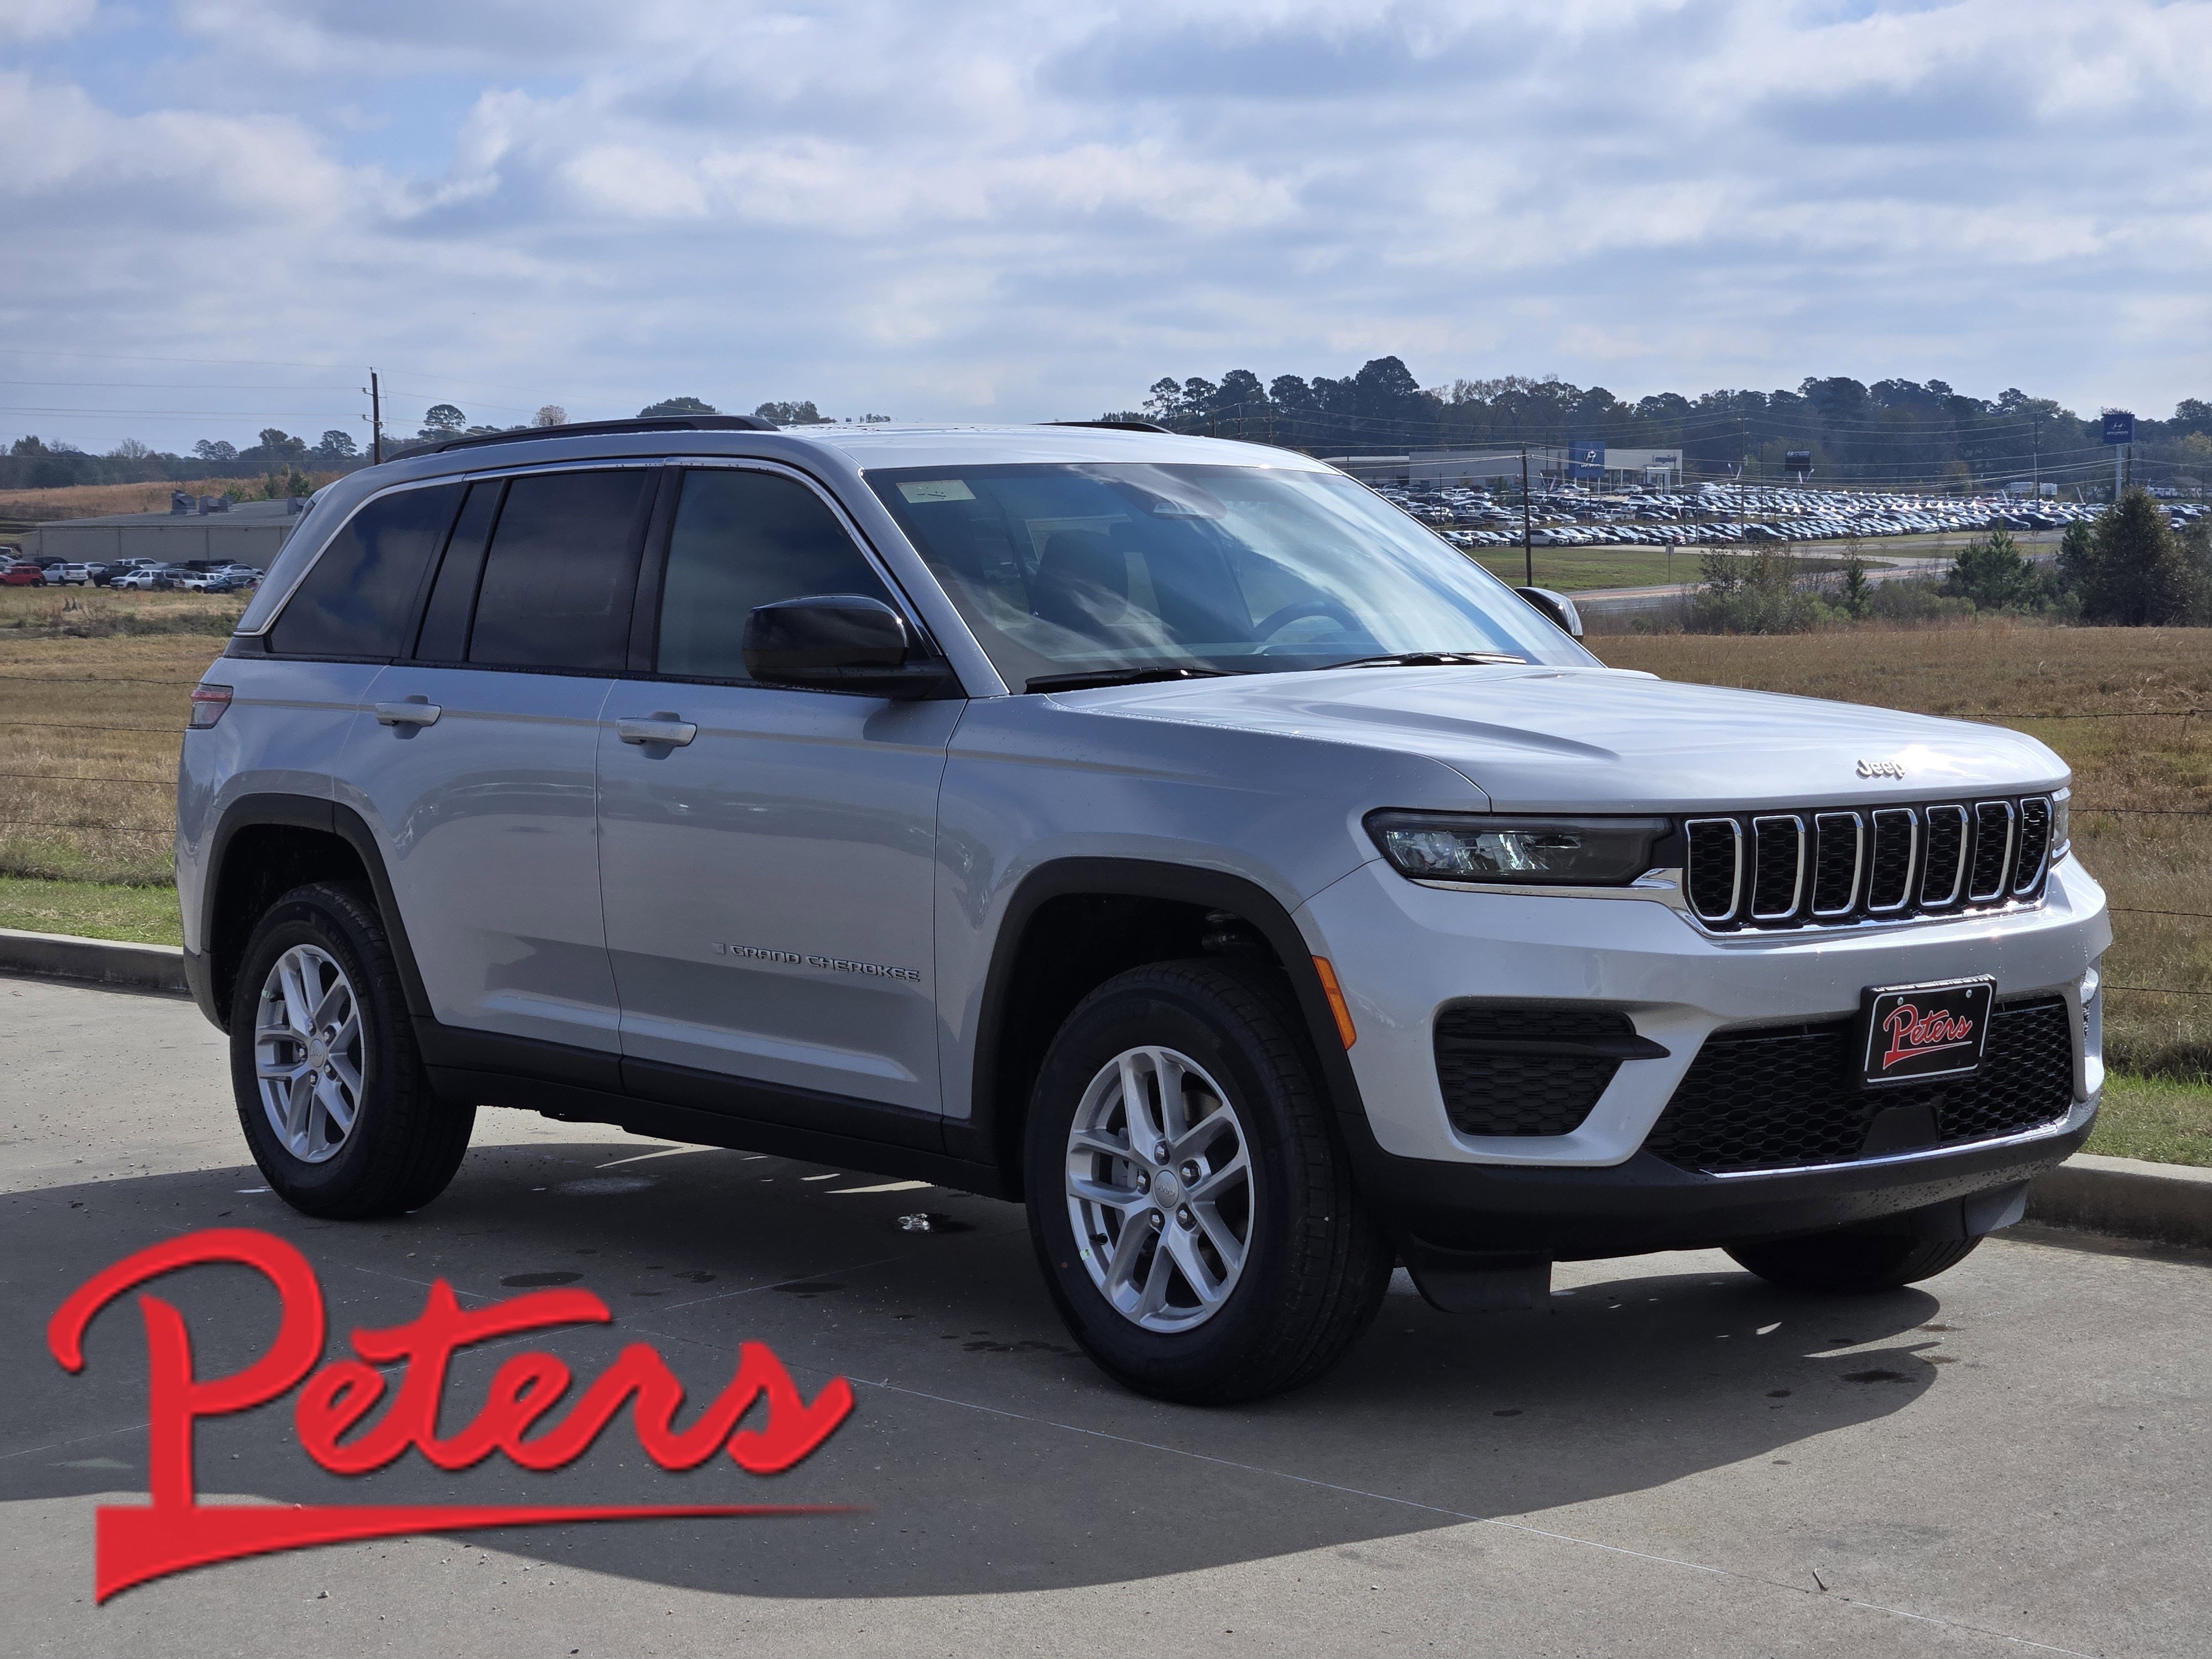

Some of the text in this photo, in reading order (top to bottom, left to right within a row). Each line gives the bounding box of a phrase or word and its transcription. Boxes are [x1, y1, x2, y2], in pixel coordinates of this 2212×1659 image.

[1855, 758, 1907, 781] Jeep
[730, 945, 921, 982] GRAND CHEROKEE
[1883, 1004, 1973, 1070] Peters
